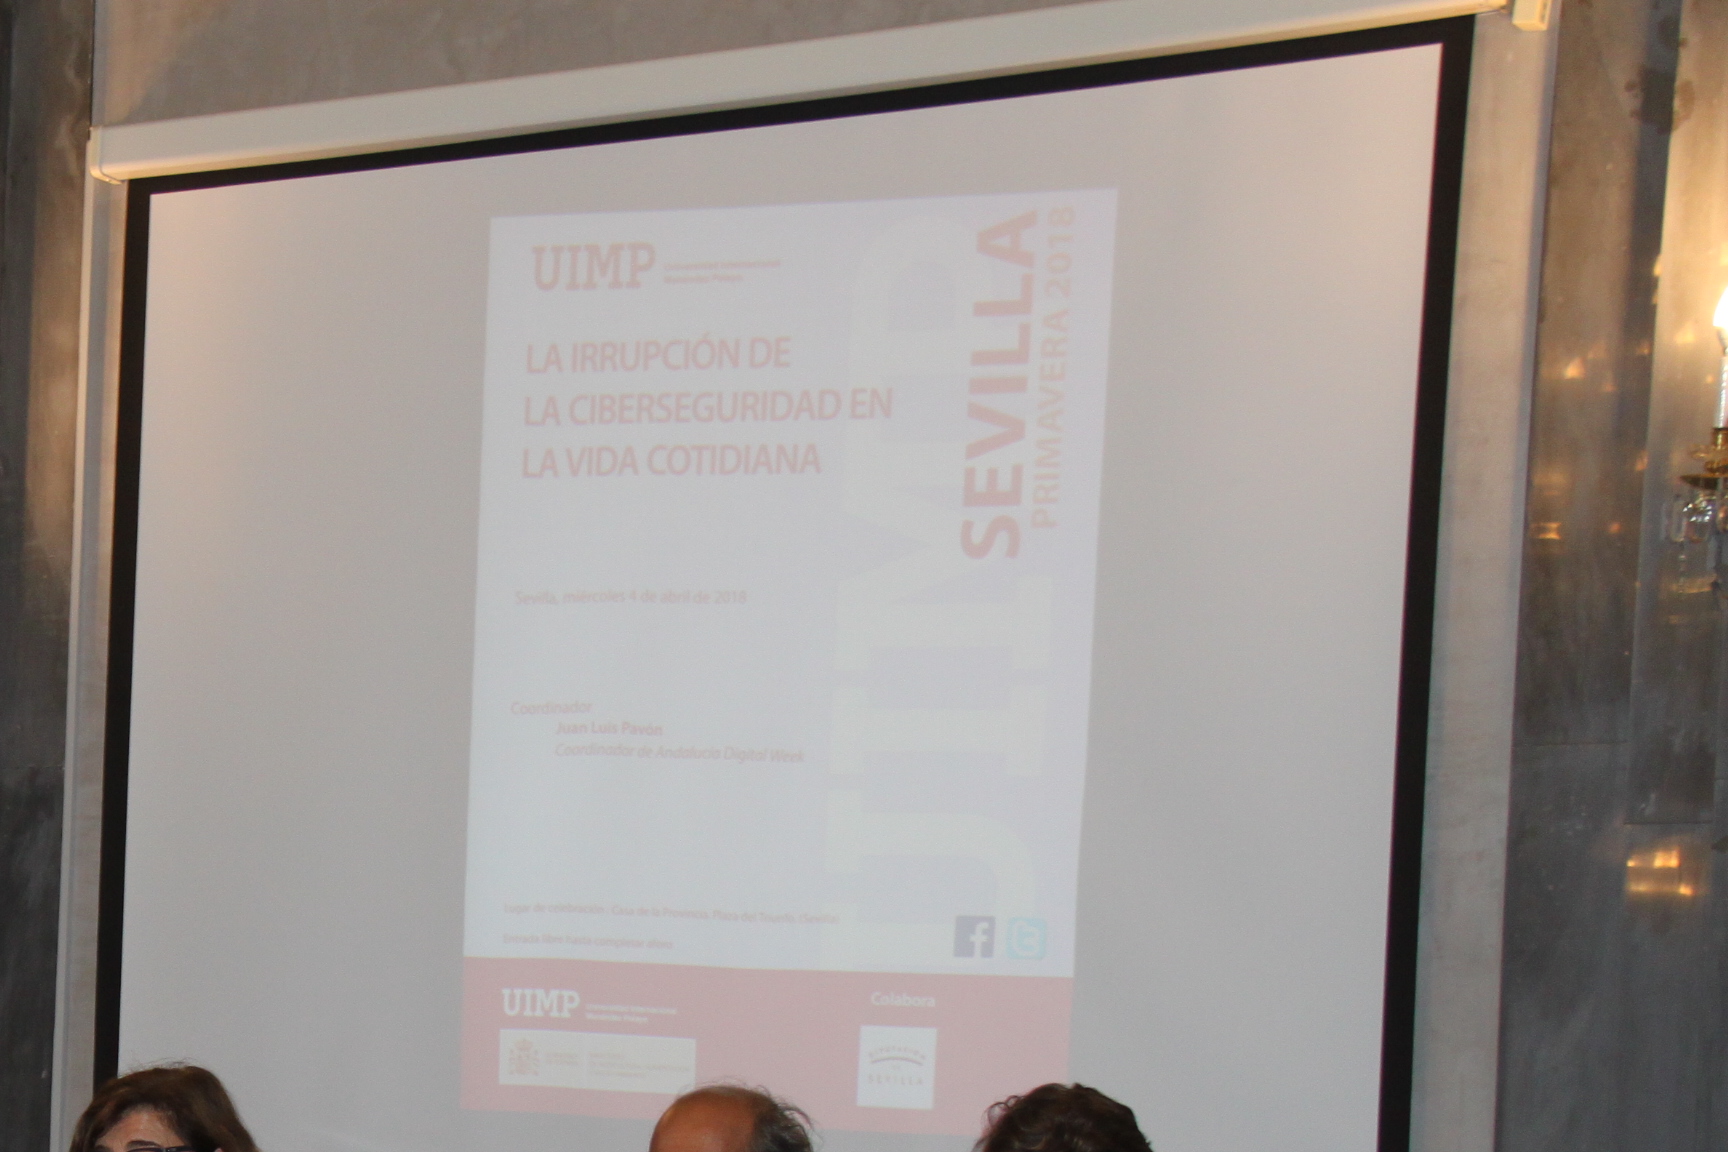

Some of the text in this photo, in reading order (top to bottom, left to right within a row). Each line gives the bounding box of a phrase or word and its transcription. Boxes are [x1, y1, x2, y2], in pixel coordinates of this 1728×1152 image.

[531, 241, 656, 292] UIMP
[526, 333, 791, 374] LA IRRUPCIÓN DE
[1031, 206, 1077, 528] PRIMAVERA 2018
[960, 210, 1038, 558] SEVILLA
[524, 387, 893, 427] LA CIBERSEGURIDAD EN
[522, 443, 823, 479] LA VIDA COTIDIANA
[714, 589, 747, 604] 2018
[510, 700, 593, 714] Coordinador
[556, 720, 663, 736] Juan Luis Pavón
[555, 743, 634, 758] Coordinador
[637, 745, 653, 759] de
[502, 988, 581, 1018] UIMP
[869, 991, 937, 1008] Colabora
